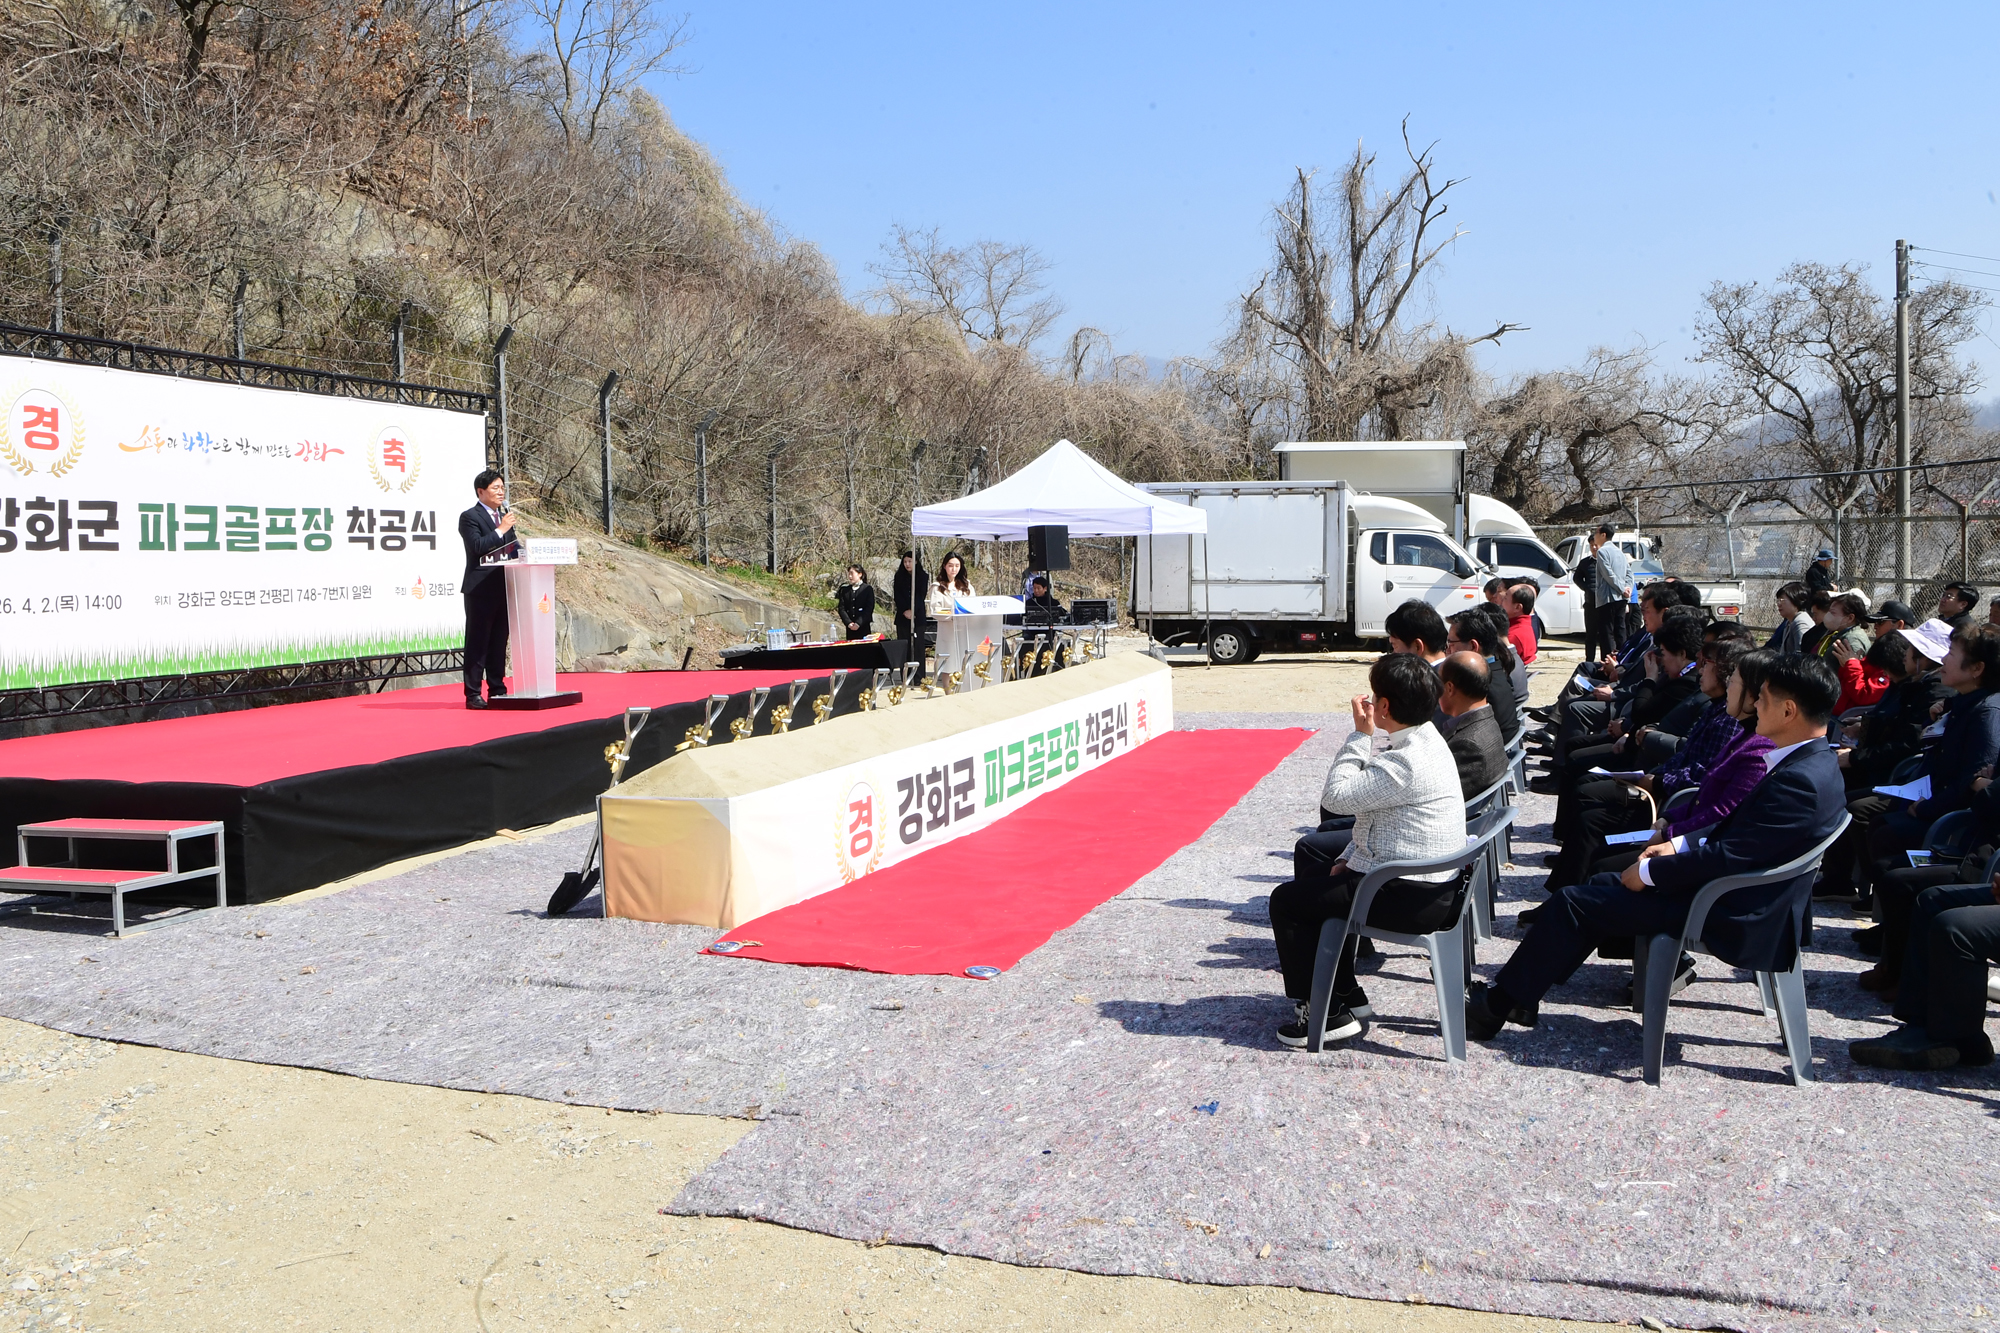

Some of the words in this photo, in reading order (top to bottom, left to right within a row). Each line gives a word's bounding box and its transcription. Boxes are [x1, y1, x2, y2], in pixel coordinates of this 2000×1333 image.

[22, 404, 61, 452] 경
[118, 424, 177, 454] 소통과
[182, 431, 232, 454] 화합으로
[235, 437, 262, 456] 함께
[266, 444, 292, 458] 만드는
[294, 439, 345, 462] 강화
[382, 437, 407, 473] 축
[138, 502, 334, 553] 파크골프장
[347, 505, 437, 551] 착공식
[0, 597, 16, 614] 6.
[22, 597, 36, 614] 4.
[41, 594, 79, 613] 2.(목)
[84, 594, 122, 610] 14:00
[154, 595, 171, 606] 위치
[177, 591, 216, 609] 강화군
[219, 590, 256, 606] 양도면
[259, 588, 293, 604] 건평리
[296, 586, 349, 602] 748-7번지
[352, 585, 372, 600] 일원
[429, 583, 455, 597] 강화군
[981, 600, 998, 609] 강화군
[848, 794, 874, 859] 경
[896, 756, 976, 846] 강화군
[983, 719, 1081, 808] 파크골프장
[1085, 701, 1128, 761] 착공식
[1136, 698, 1148, 732] 축
